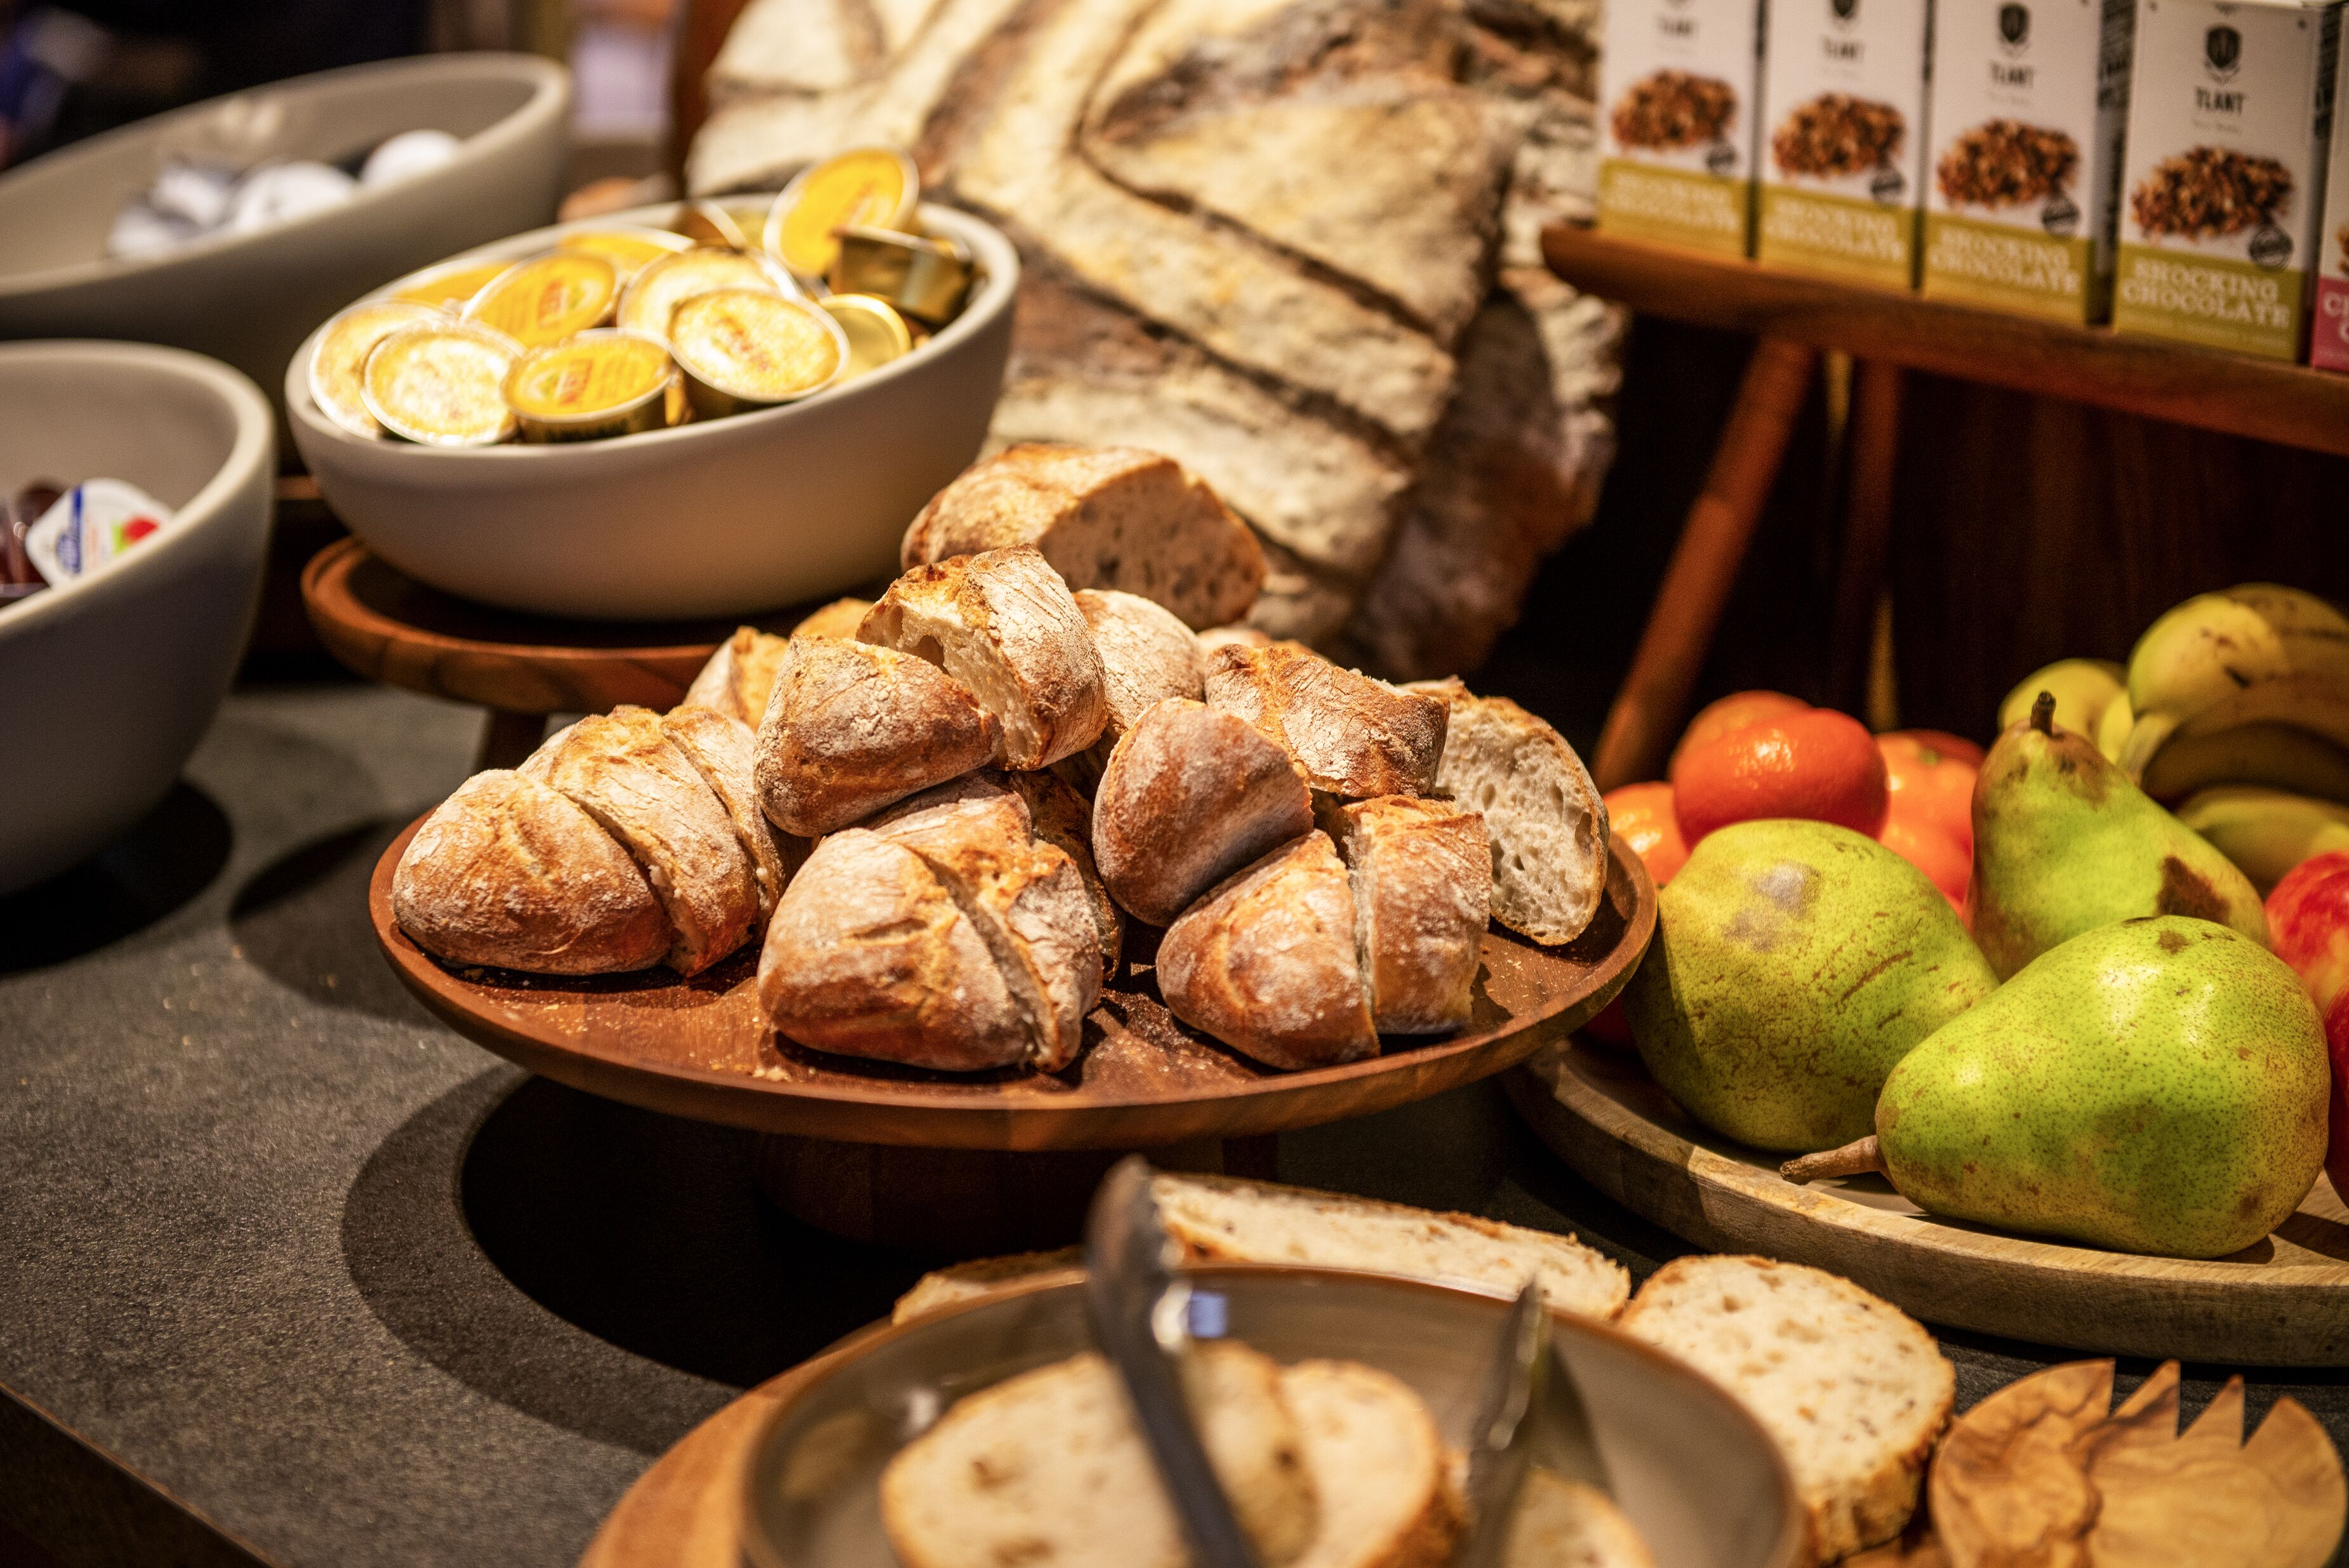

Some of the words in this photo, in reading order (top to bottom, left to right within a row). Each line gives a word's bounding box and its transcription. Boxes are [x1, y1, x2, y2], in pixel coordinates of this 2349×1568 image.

[2195, 85, 2245, 115] TLANT
[2134, 258, 2280, 302] SHOCKING
[2120, 277, 2291, 328] CHOCOLATE
